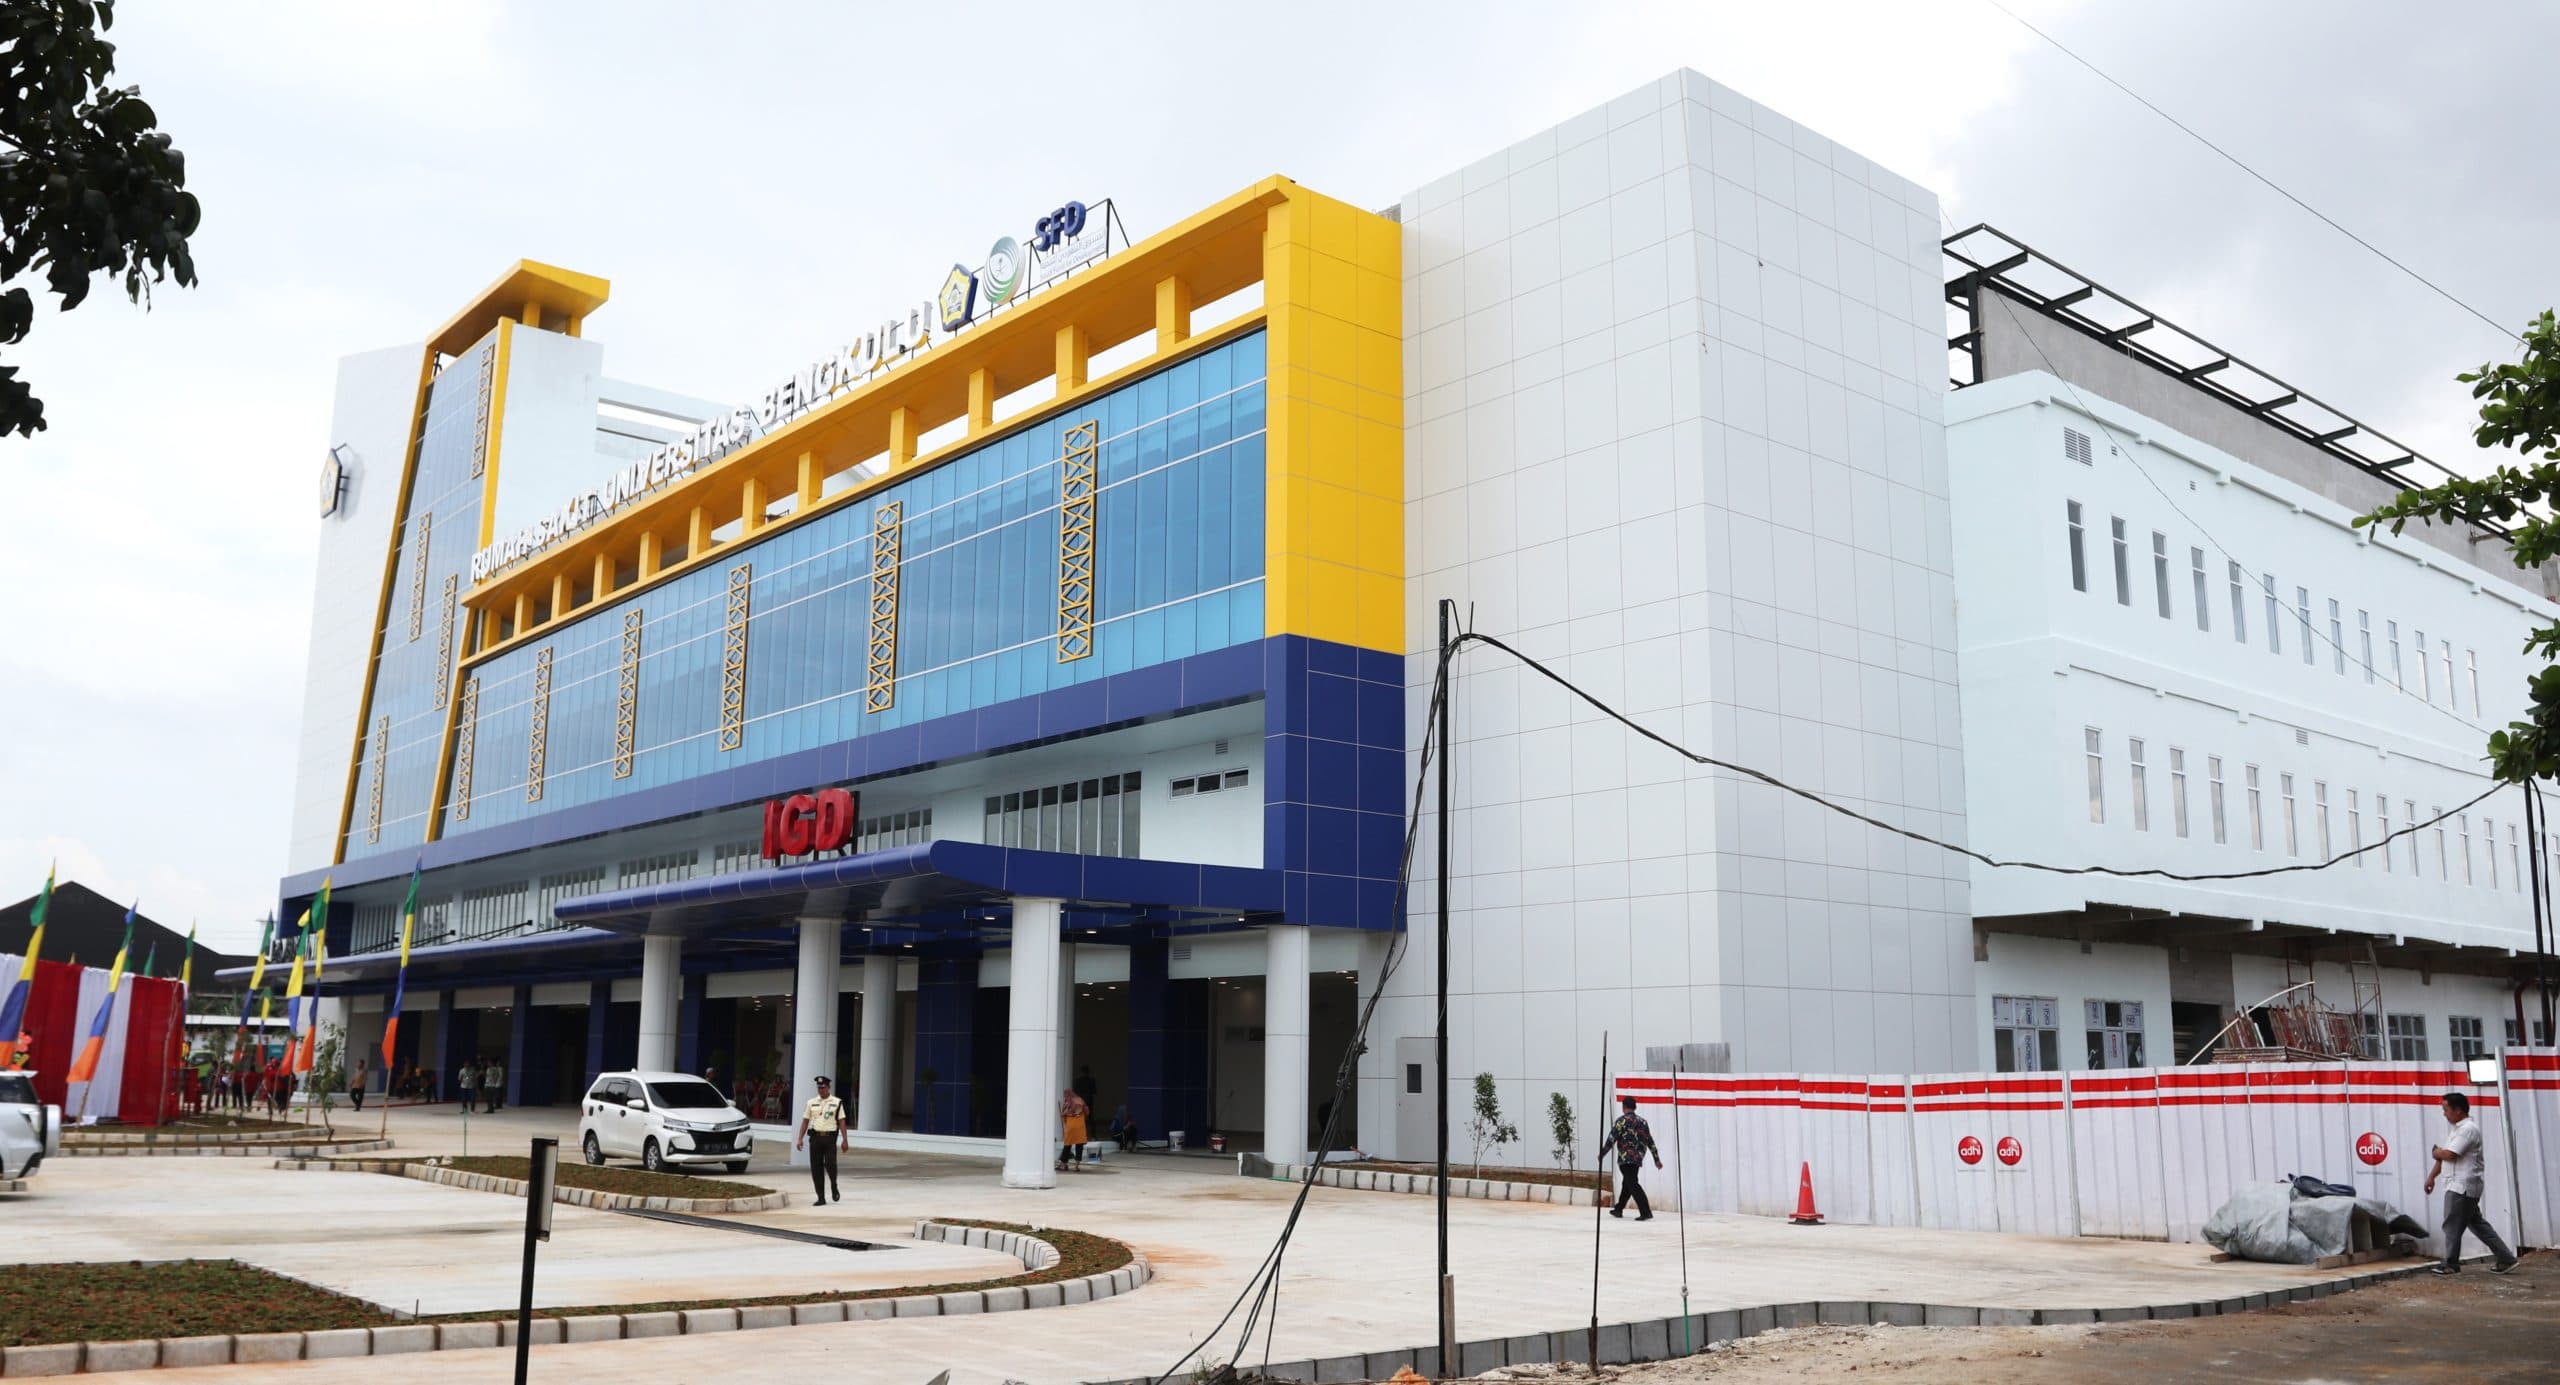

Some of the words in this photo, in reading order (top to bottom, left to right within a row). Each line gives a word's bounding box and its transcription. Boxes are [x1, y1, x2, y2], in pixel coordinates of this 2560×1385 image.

[1035, 201, 1087, 252] SFD
[471, 529, 529, 582] RUMAH
[533, 489, 599, 547] SAKIT
[604, 401, 753, 511] UNIVERSITAS
[761, 300, 933, 428] BENGKULU
[763, 787, 855, 860] IGD
[1960, 1143, 1982, 1156] adhi
[1999, 1143, 2020, 1157] adhi
[2359, 1143, 2385, 1155] adhi
